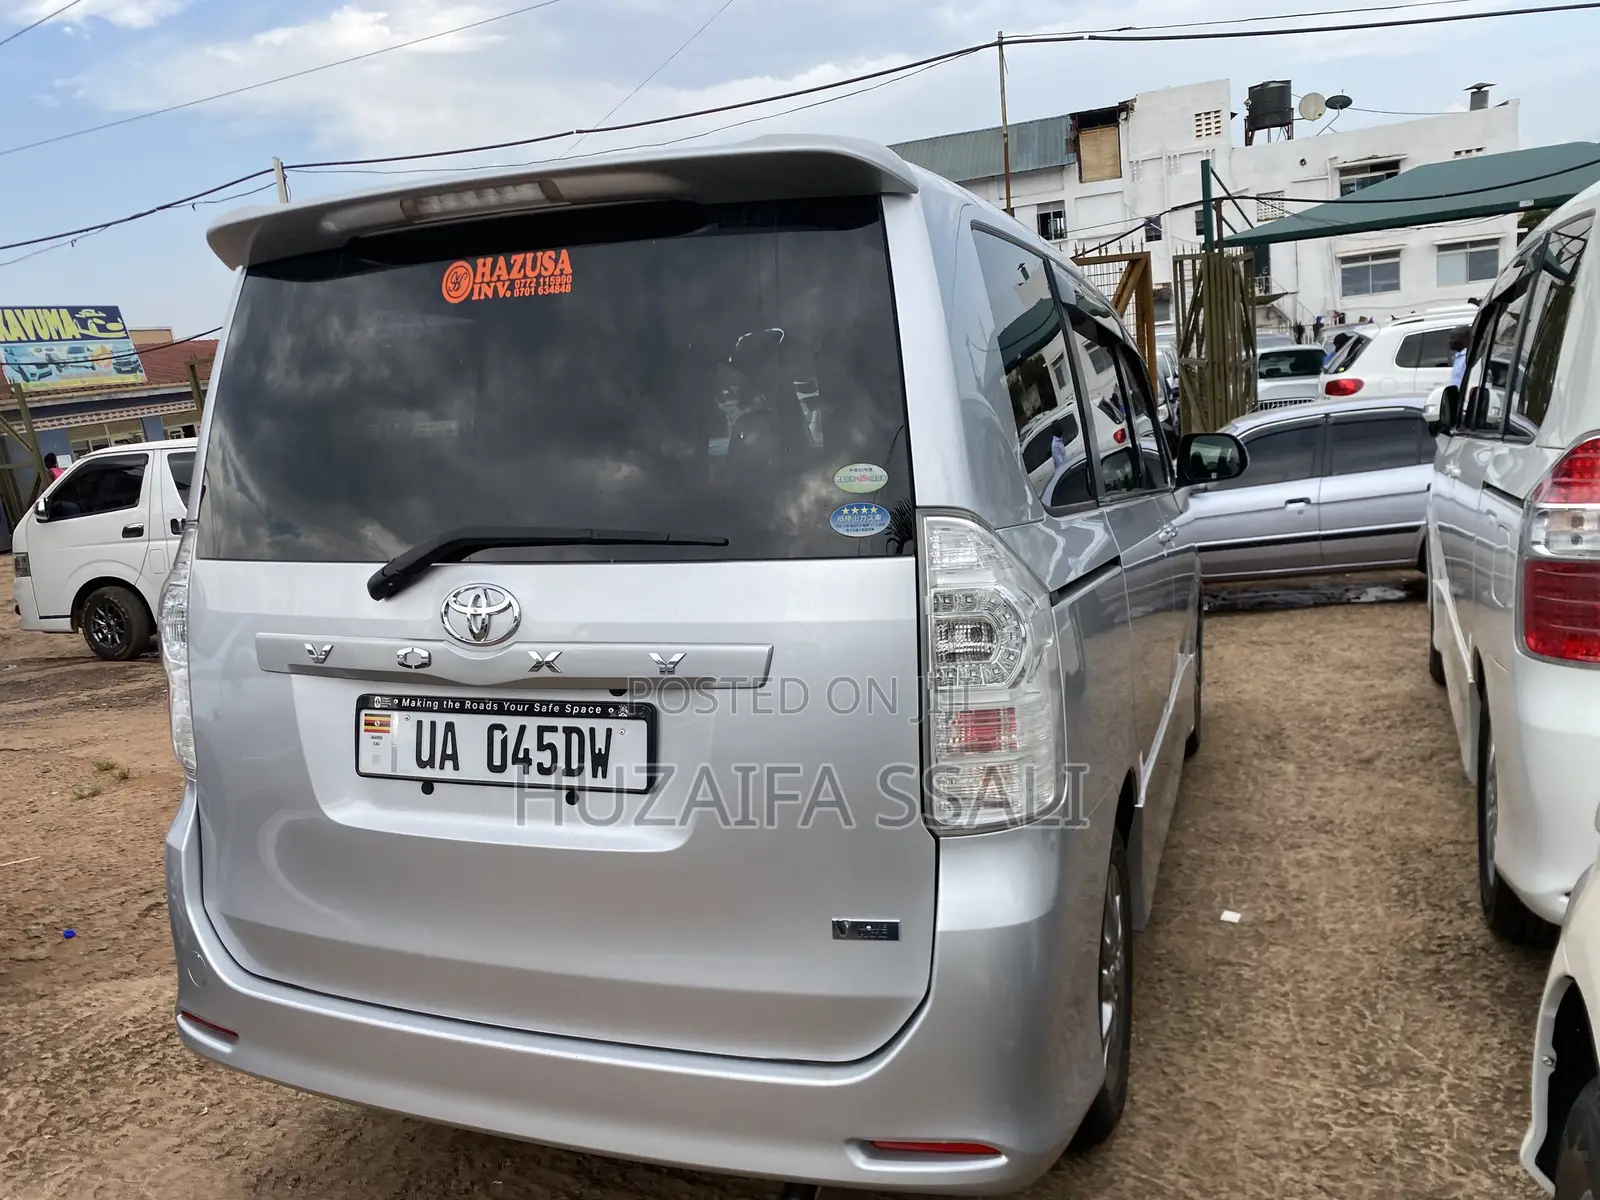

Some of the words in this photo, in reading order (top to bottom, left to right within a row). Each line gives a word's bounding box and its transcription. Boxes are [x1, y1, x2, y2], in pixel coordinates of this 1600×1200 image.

[474, 249, 573, 283] HAZUSA
[471, 280, 511, 300] INV.
[513, 286, 535, 297] 0701
[514, 278, 536, 289] 0772
[304, 642, 687, 676] VOXY
[401, 698, 439, 710] Making
[443, 700, 460, 709] the
[465, 701, 498, 711] Roads
[503, 702, 529, 711] Your
[534, 703, 560, 713] Safe
[565, 704, 601, 715] Space
[415, 719, 460, 771] UA
[486, 723, 613, 779] 045DW
